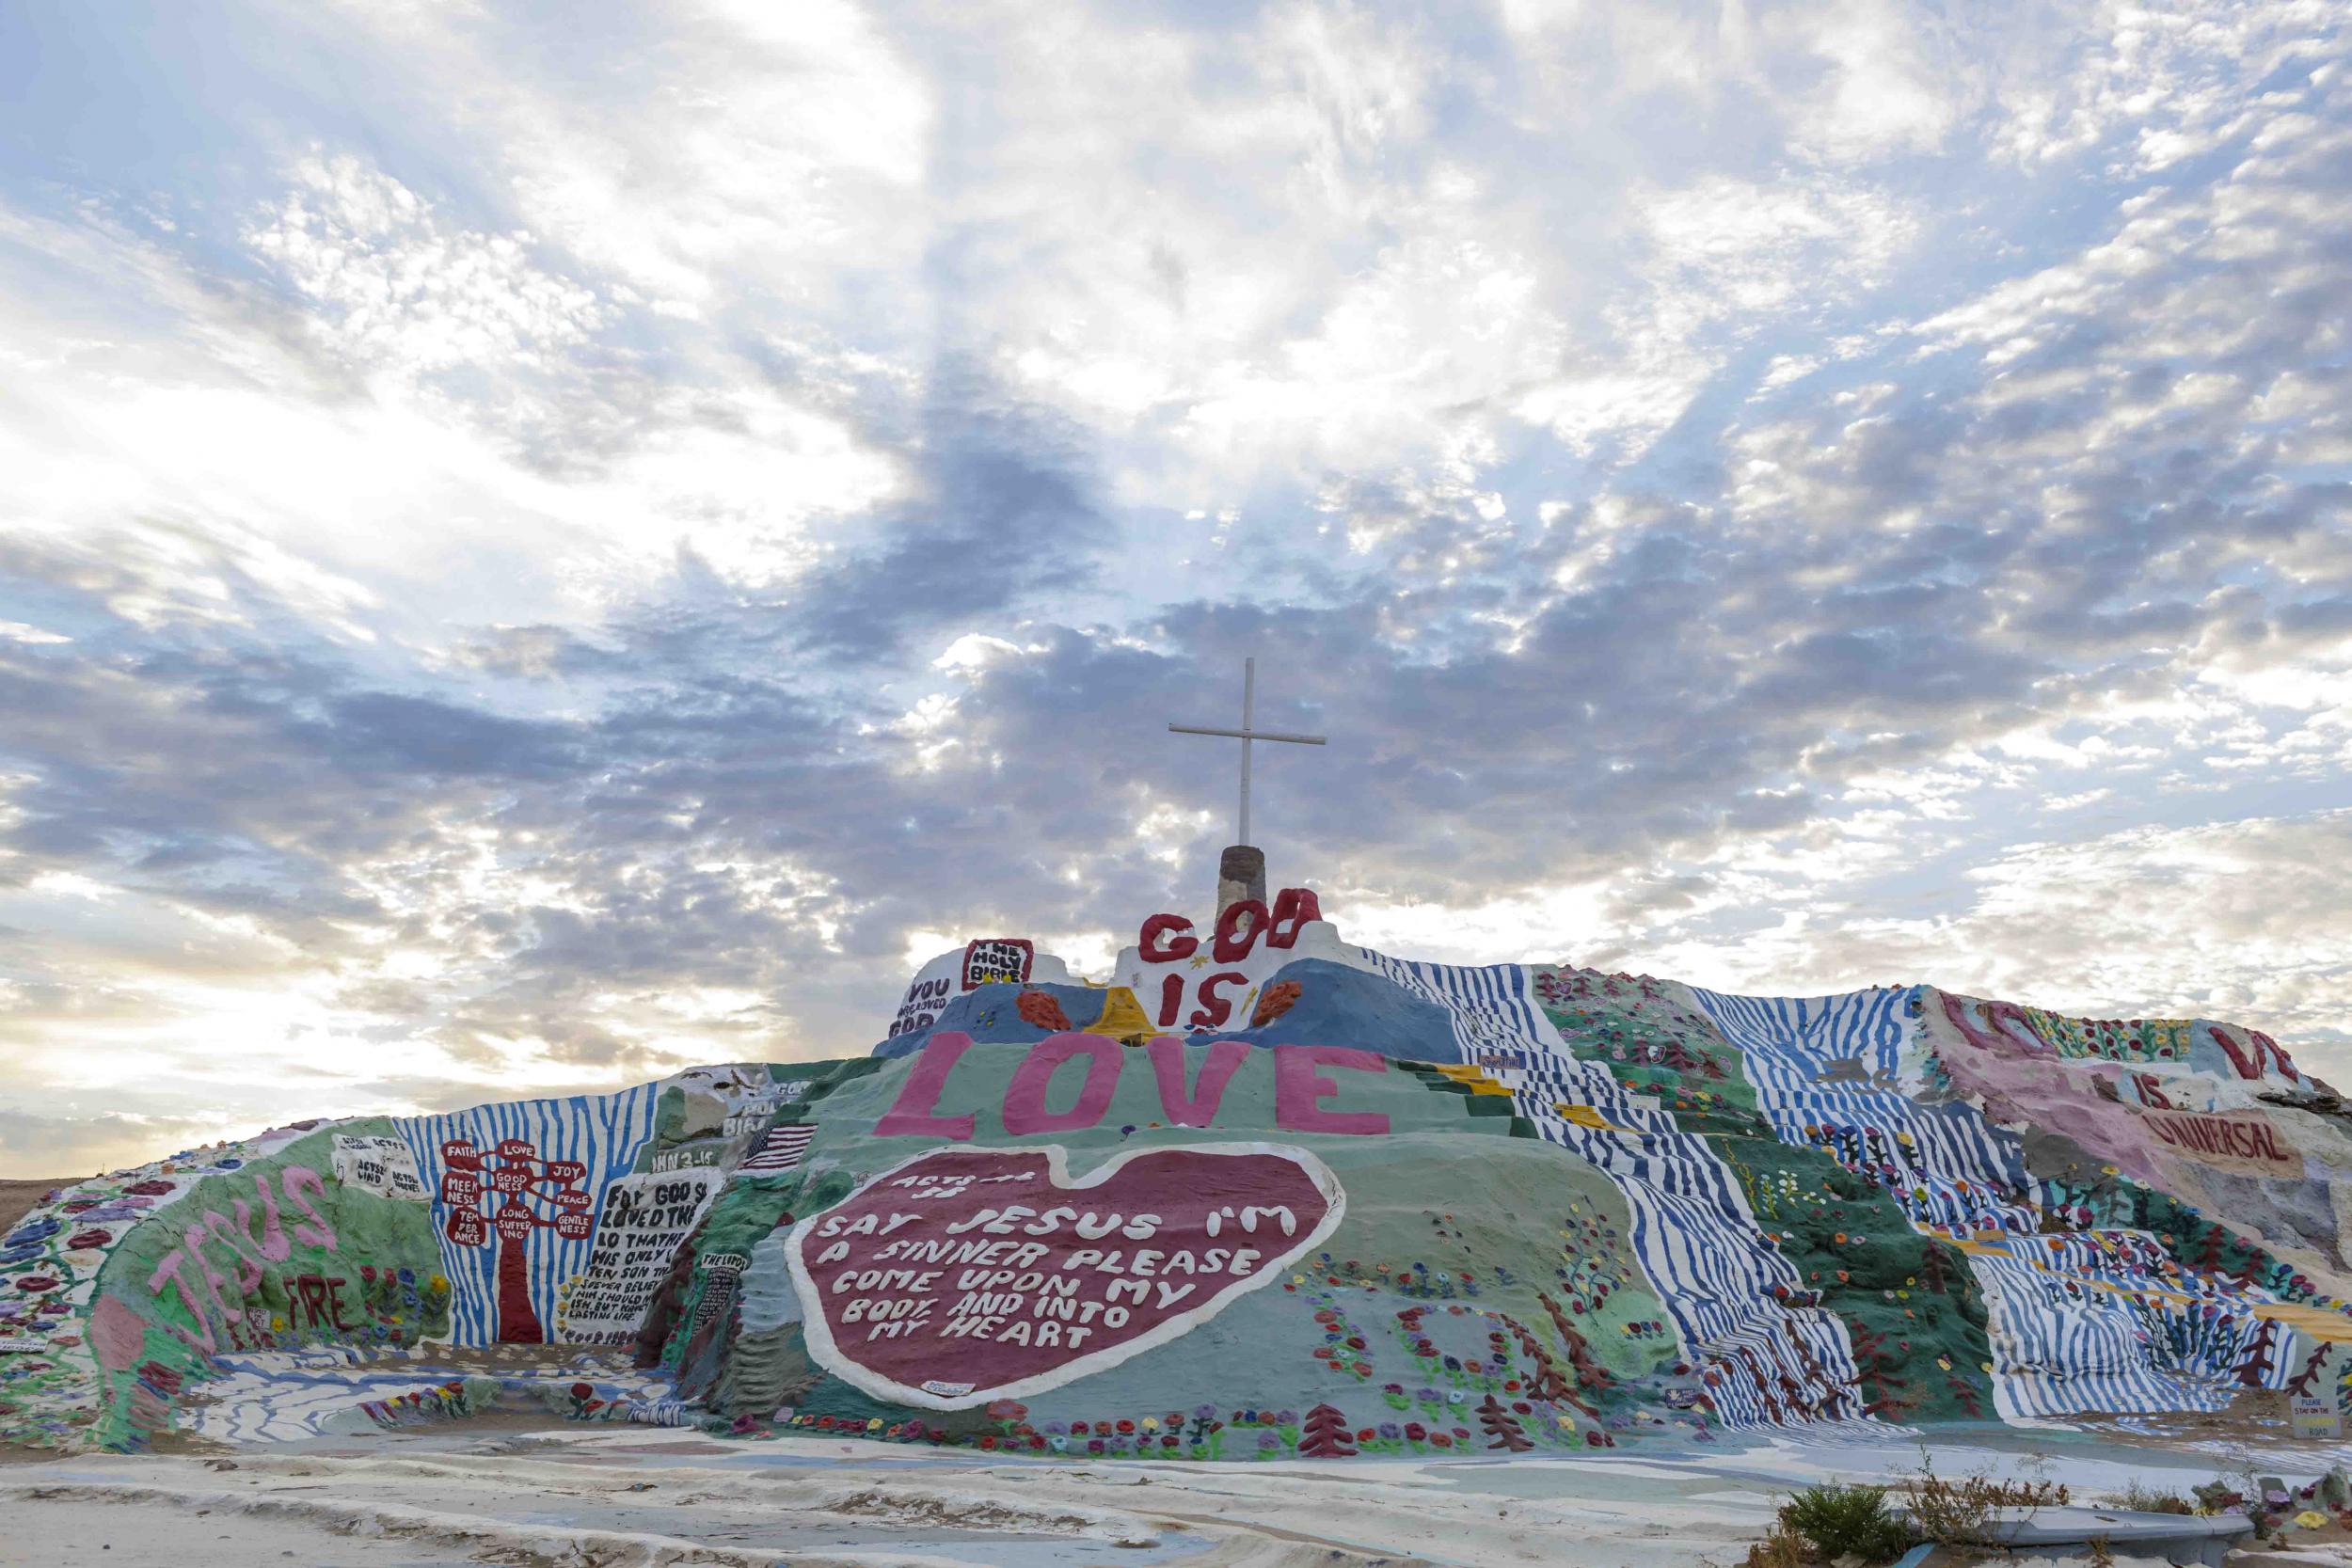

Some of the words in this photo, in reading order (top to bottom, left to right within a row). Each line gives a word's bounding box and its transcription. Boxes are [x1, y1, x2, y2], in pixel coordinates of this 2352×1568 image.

[1138, 888, 1323, 964] GOD
[974, 952, 1021, 969] HOLY
[970, 965, 1020, 983] BIBLE
[908, 977, 950, 1003] YOU
[1158, 973, 1249, 1026] IS
[873, 1031, 1390, 1139] LOVE
[2132, 1073, 2169, 1109] IS
[2141, 1115, 2289, 1161] UNIVERSAL
[447, 1146, 477, 1158] FAITH
[504, 1145, 533, 1157] LOVE
[496, 1172, 528, 1183] GOOD
[553, 1165, 580, 1180] JOY
[448, 1178, 479, 1193] MEEK
[498, 1181, 522, 1192] NESS
[447, 1192, 475, 1204] NESS
[557, 1194, 589, 1205] PEACE
[655, 1180, 691, 1206] GOD
[459, 1211, 480, 1222] TEM
[501, 1210, 530, 1219] LONG
[558, 1215, 589, 1227] GENTLE
[600, 1208, 664, 1229] LOVED
[667, 1204, 697, 1228] THE
[458, 1223, 478, 1234] PER
[499, 1220, 532, 1230] SUFFER
[559, 1224, 587, 1235] NESS
[818, 1213, 924, 1238] SAY
[946, 1205, 1163, 1241] JESUS
[1206, 1206, 1296, 1238] I'M
[453, 1232, 481, 1244] ANCE
[503, 1229, 525, 1240] ING
[592, 1249, 621, 1266] HIS
[625, 1248, 666, 1265] ONLY
[703, 1254, 723, 1267] THE
[816, 1240, 850, 1265] A
[872, 1238, 1050, 1269] SINNER
[1062, 1248, 1262, 1276] PLEASE
[620, 1266, 650, 1279] SON
[580, 1278, 622, 1292] SOEVER
[832, 1269, 943, 1294] COME
[957, 1270, 1081, 1298] UPON
[1105, 1278, 1196, 1310] MY
[575, 1291, 598, 1300] HIM
[597, 1291, 643, 1305] SHOULD
[595, 1301, 620, 1312] BUT
[946, 1291, 1024, 1317] AND
[1034, 1295, 1130, 1328] INTO
[568, 1310, 612, 1321] LASTING
[867, 1319, 930, 1342] MY
[940, 1316, 1092, 1349] HEART
[2301, 1398, 2322, 1406] PLEASE
[2309, 1427, 2328, 1437] ROAD
